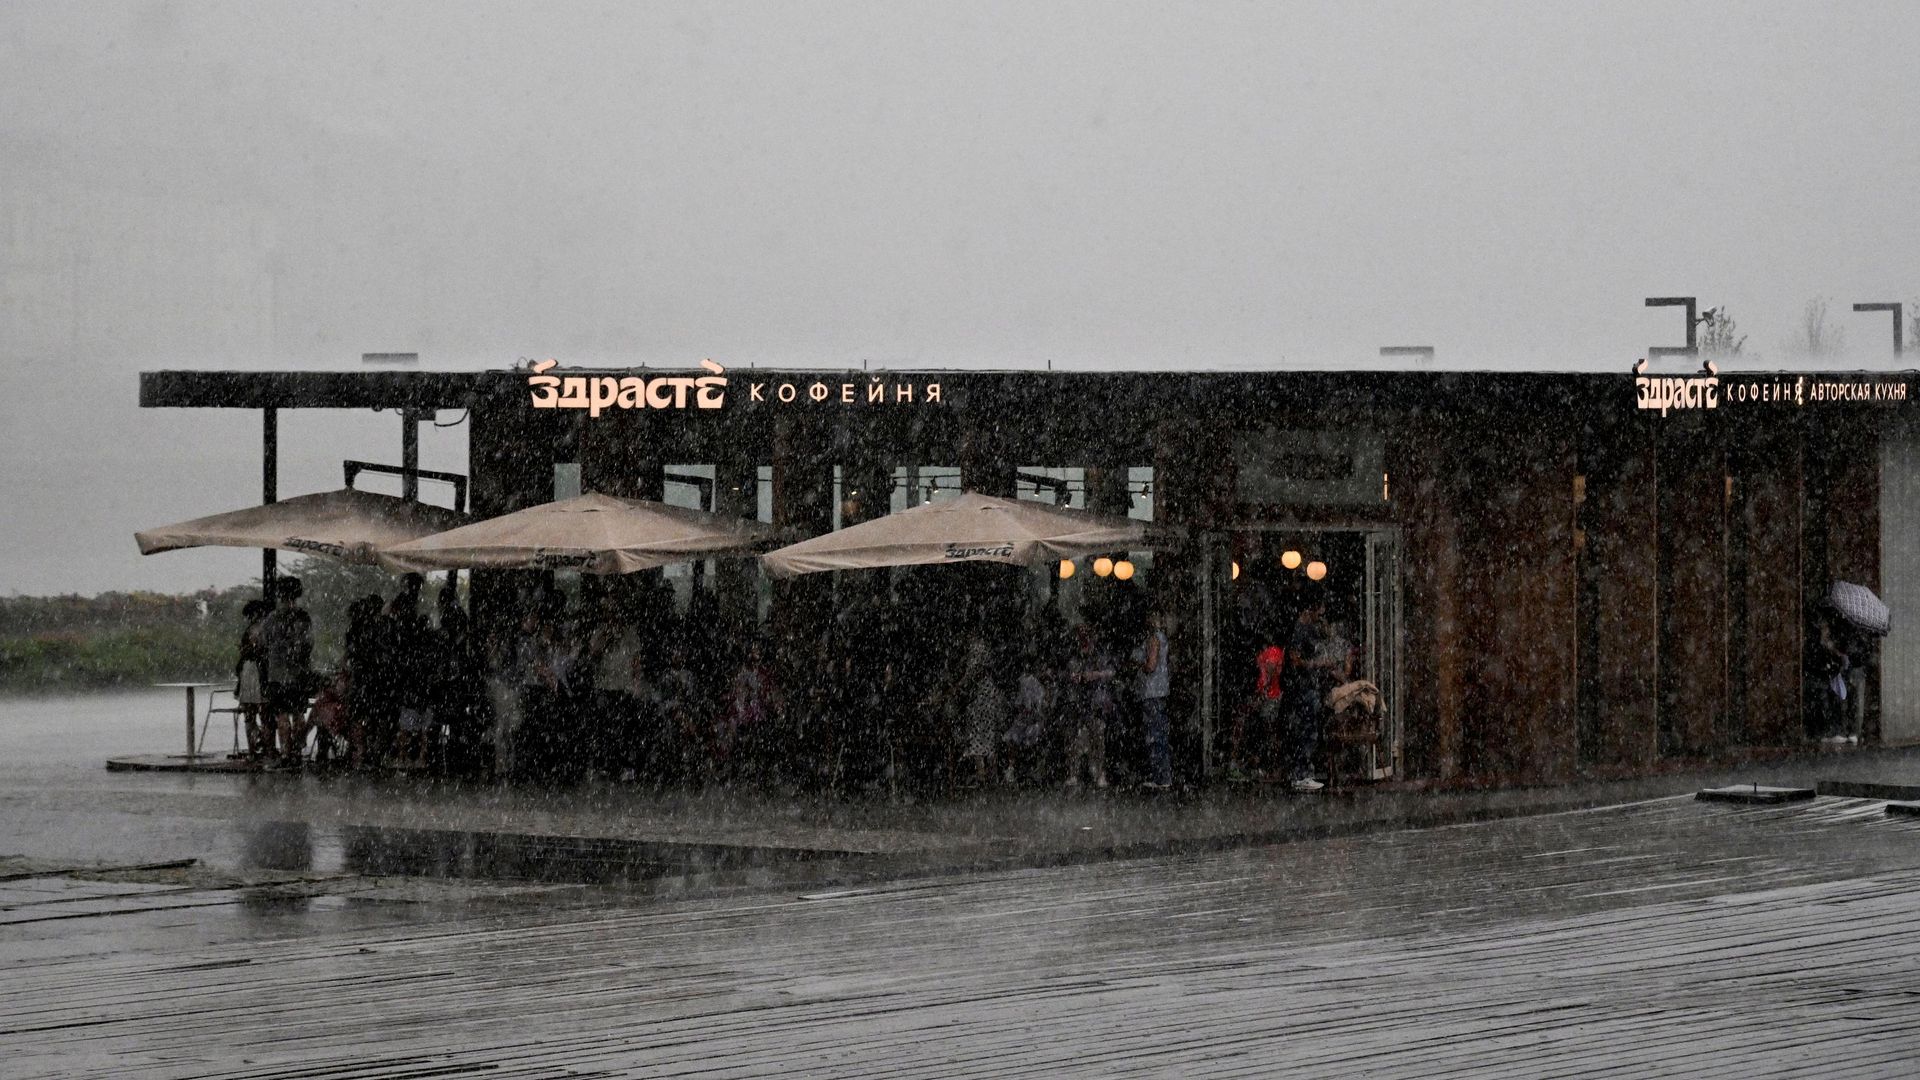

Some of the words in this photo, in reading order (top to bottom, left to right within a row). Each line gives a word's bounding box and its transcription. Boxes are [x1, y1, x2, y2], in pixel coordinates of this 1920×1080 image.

[751, 377, 941, 402] КОФЕЙНЯ
[1727, 378, 1802, 402] КОФЕЙНЯ
[1810, 383, 1871, 402] АВТОРСКАЯ
[1875, 383, 1906, 401] КУХНЯ
